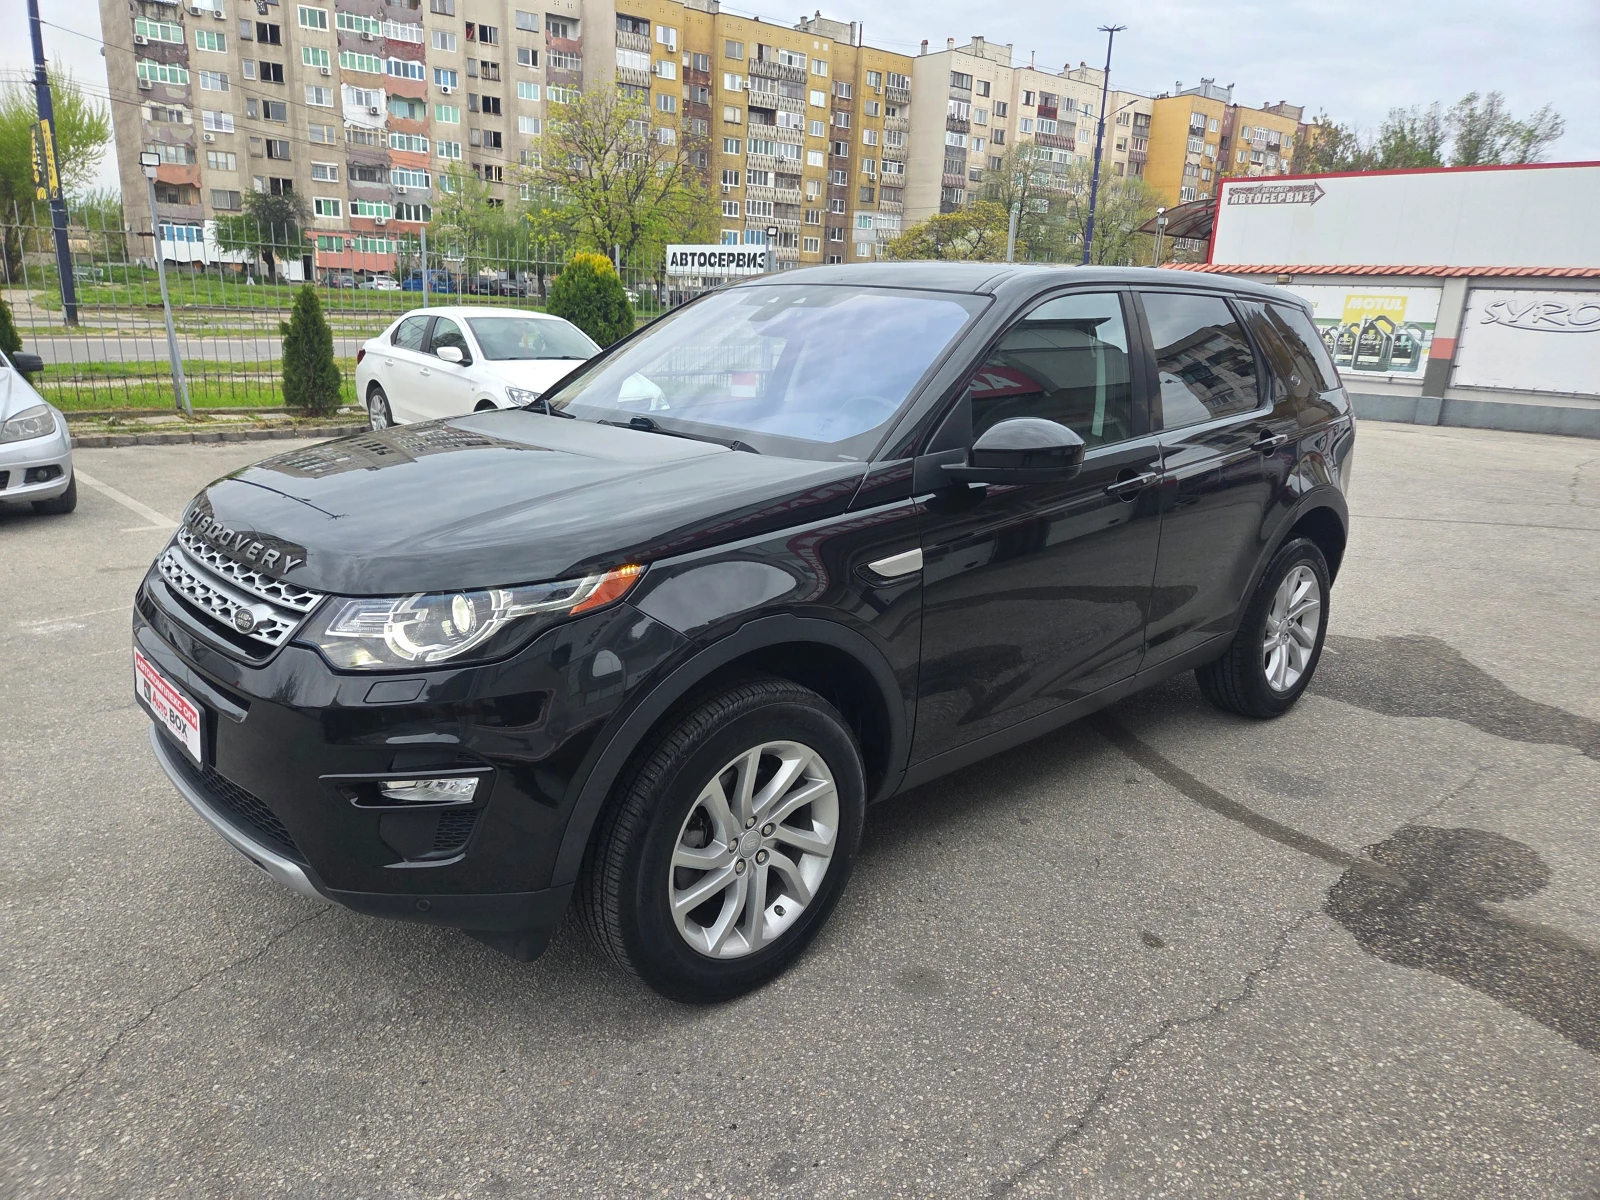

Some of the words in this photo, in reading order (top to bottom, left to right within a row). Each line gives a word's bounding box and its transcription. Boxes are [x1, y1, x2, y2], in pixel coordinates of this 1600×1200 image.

[1230, 191, 1312, 204] АВТОСЕРВИЗ
[670, 251, 766, 269] АВТОСЕРВИЗ
[1347, 297, 1404, 310] MOTUL
[188, 506, 303, 575] DISCOVERY
[169, 706, 188, 739] BOX
